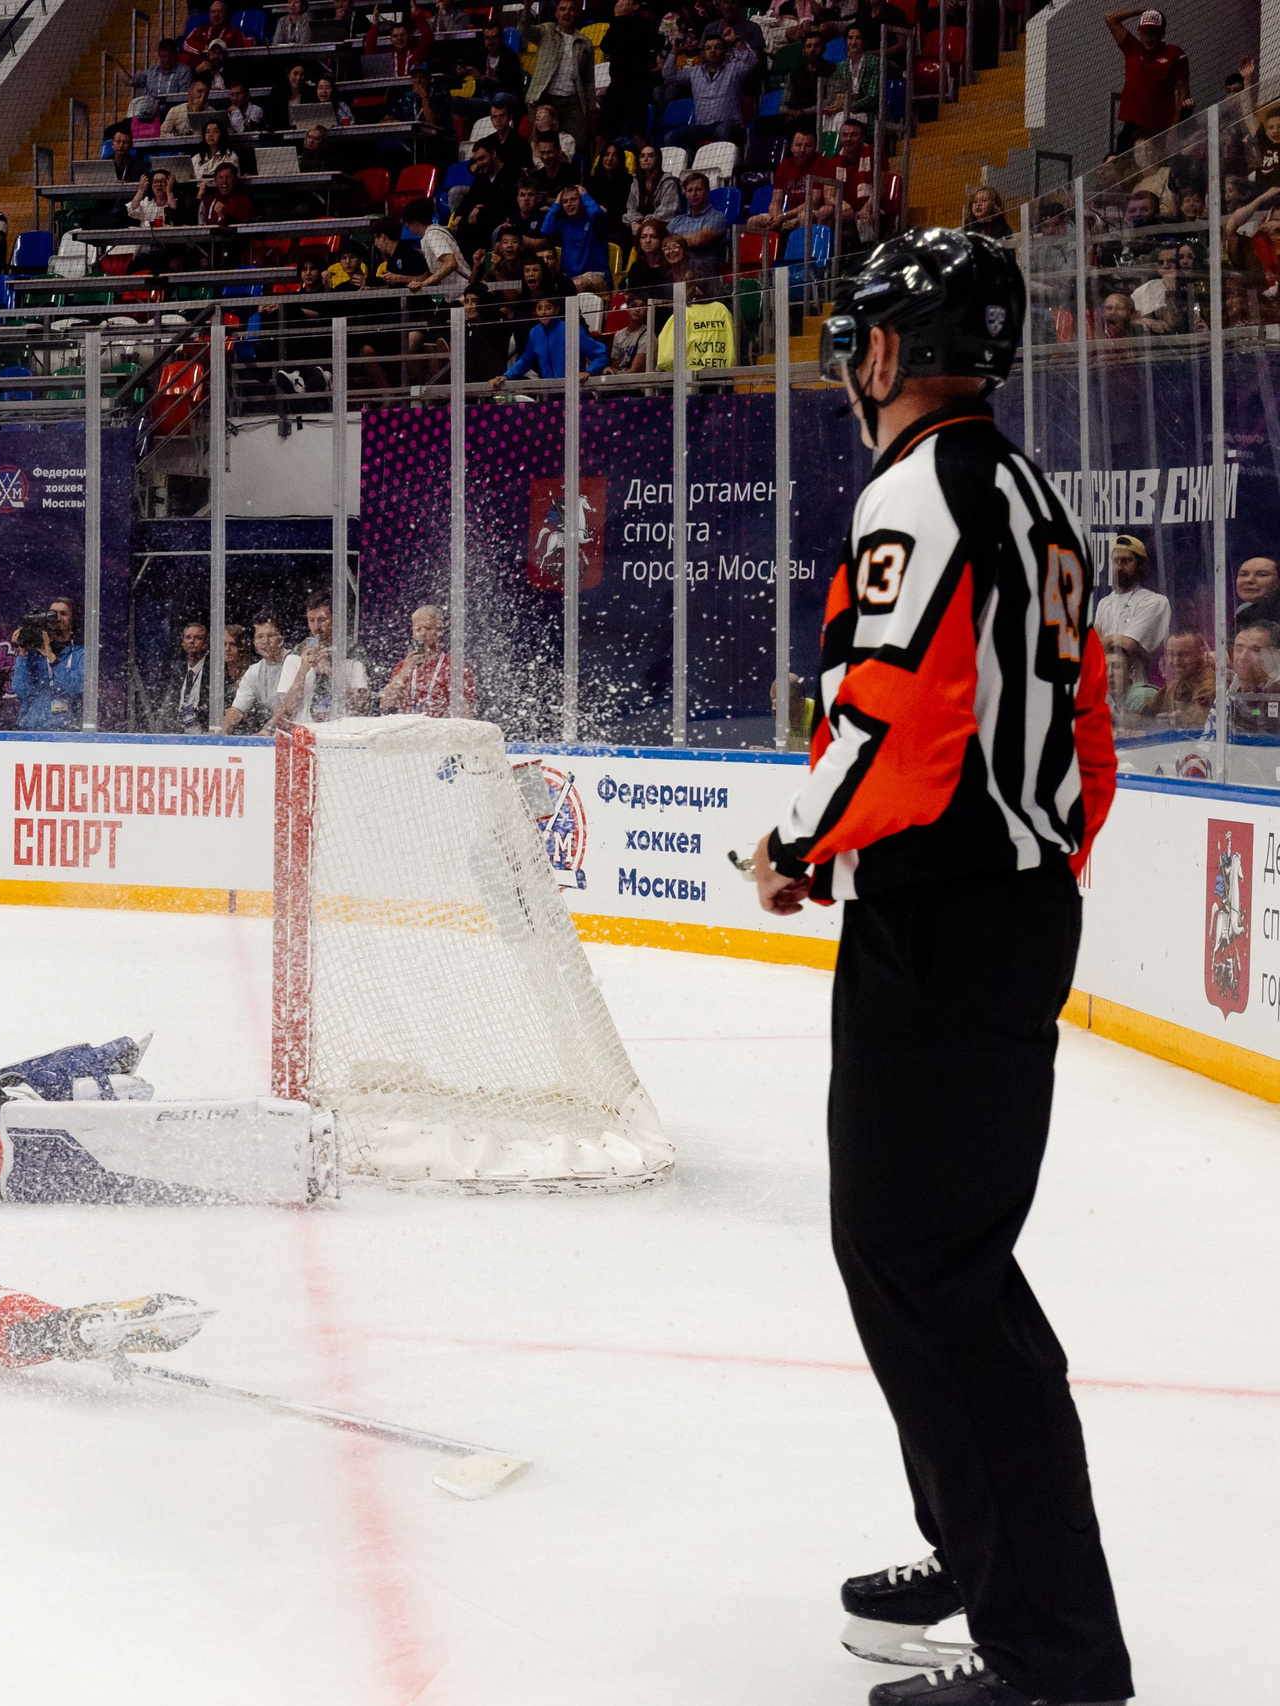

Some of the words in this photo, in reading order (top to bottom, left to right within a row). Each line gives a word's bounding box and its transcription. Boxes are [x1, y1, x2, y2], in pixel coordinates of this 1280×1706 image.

[693, 320, 725, 330] SAFETY
[32, 466, 86, 480] Федерац
[45, 484, 84, 493] хоккея
[1044, 450, 1239, 525] ОСКОВСКИЙ
[42, 498, 86, 508] Москвы
[624, 479, 797, 511] Депртамент
[622, 560, 709, 588] города
[718, 555, 815, 580] Москвы
[14, 757, 245, 818] МОСКОВСКИЙ
[597, 774, 728, 813] Федерация
[14, 817, 123, 869] СПОРТ
[625, 829, 702, 854] хоккея
[618, 867, 707, 902] Москвы
